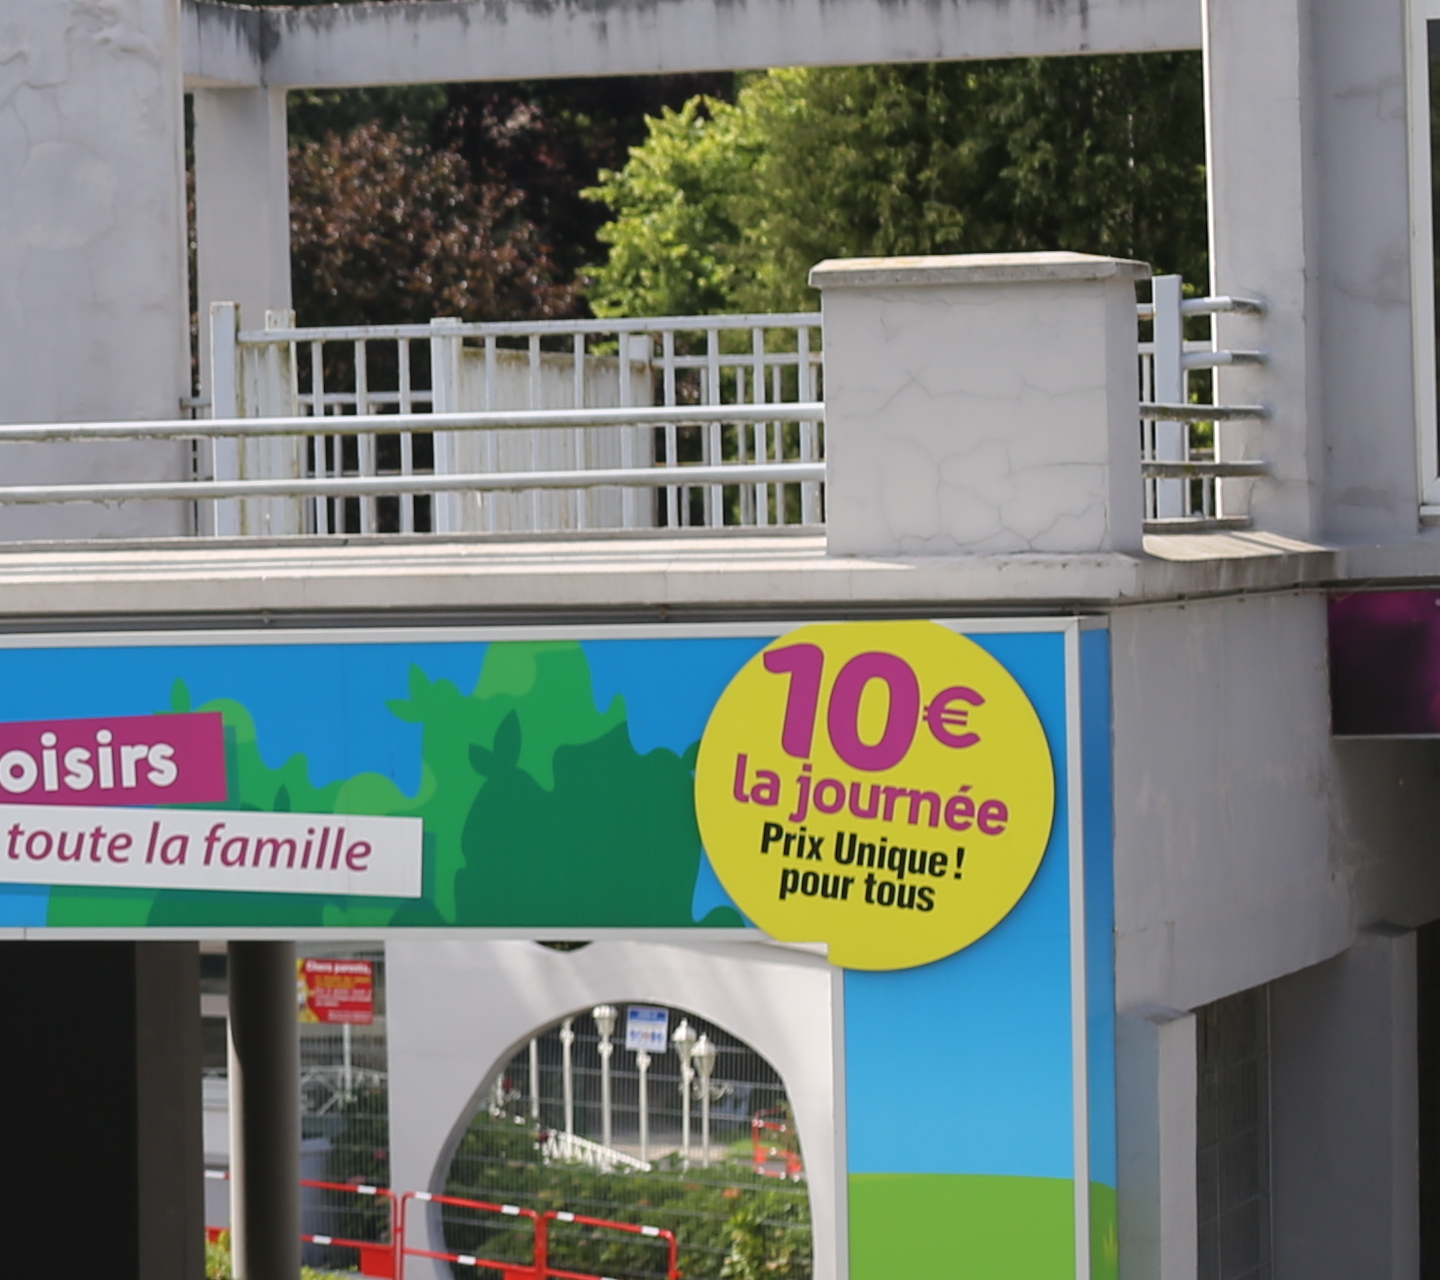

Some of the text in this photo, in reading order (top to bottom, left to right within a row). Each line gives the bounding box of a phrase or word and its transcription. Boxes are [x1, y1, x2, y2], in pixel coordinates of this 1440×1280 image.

[762, 643, 986, 773] 10€
[732, 753, 1009, 836] la journée
[7, 825, 133, 865] toute
[145, 821, 189, 865] la
[202, 822, 373, 871] famille
[760, 821, 825, 862] Prix
[834, 831, 949, 882] Unique
[779, 867, 936, 913] pour tous
